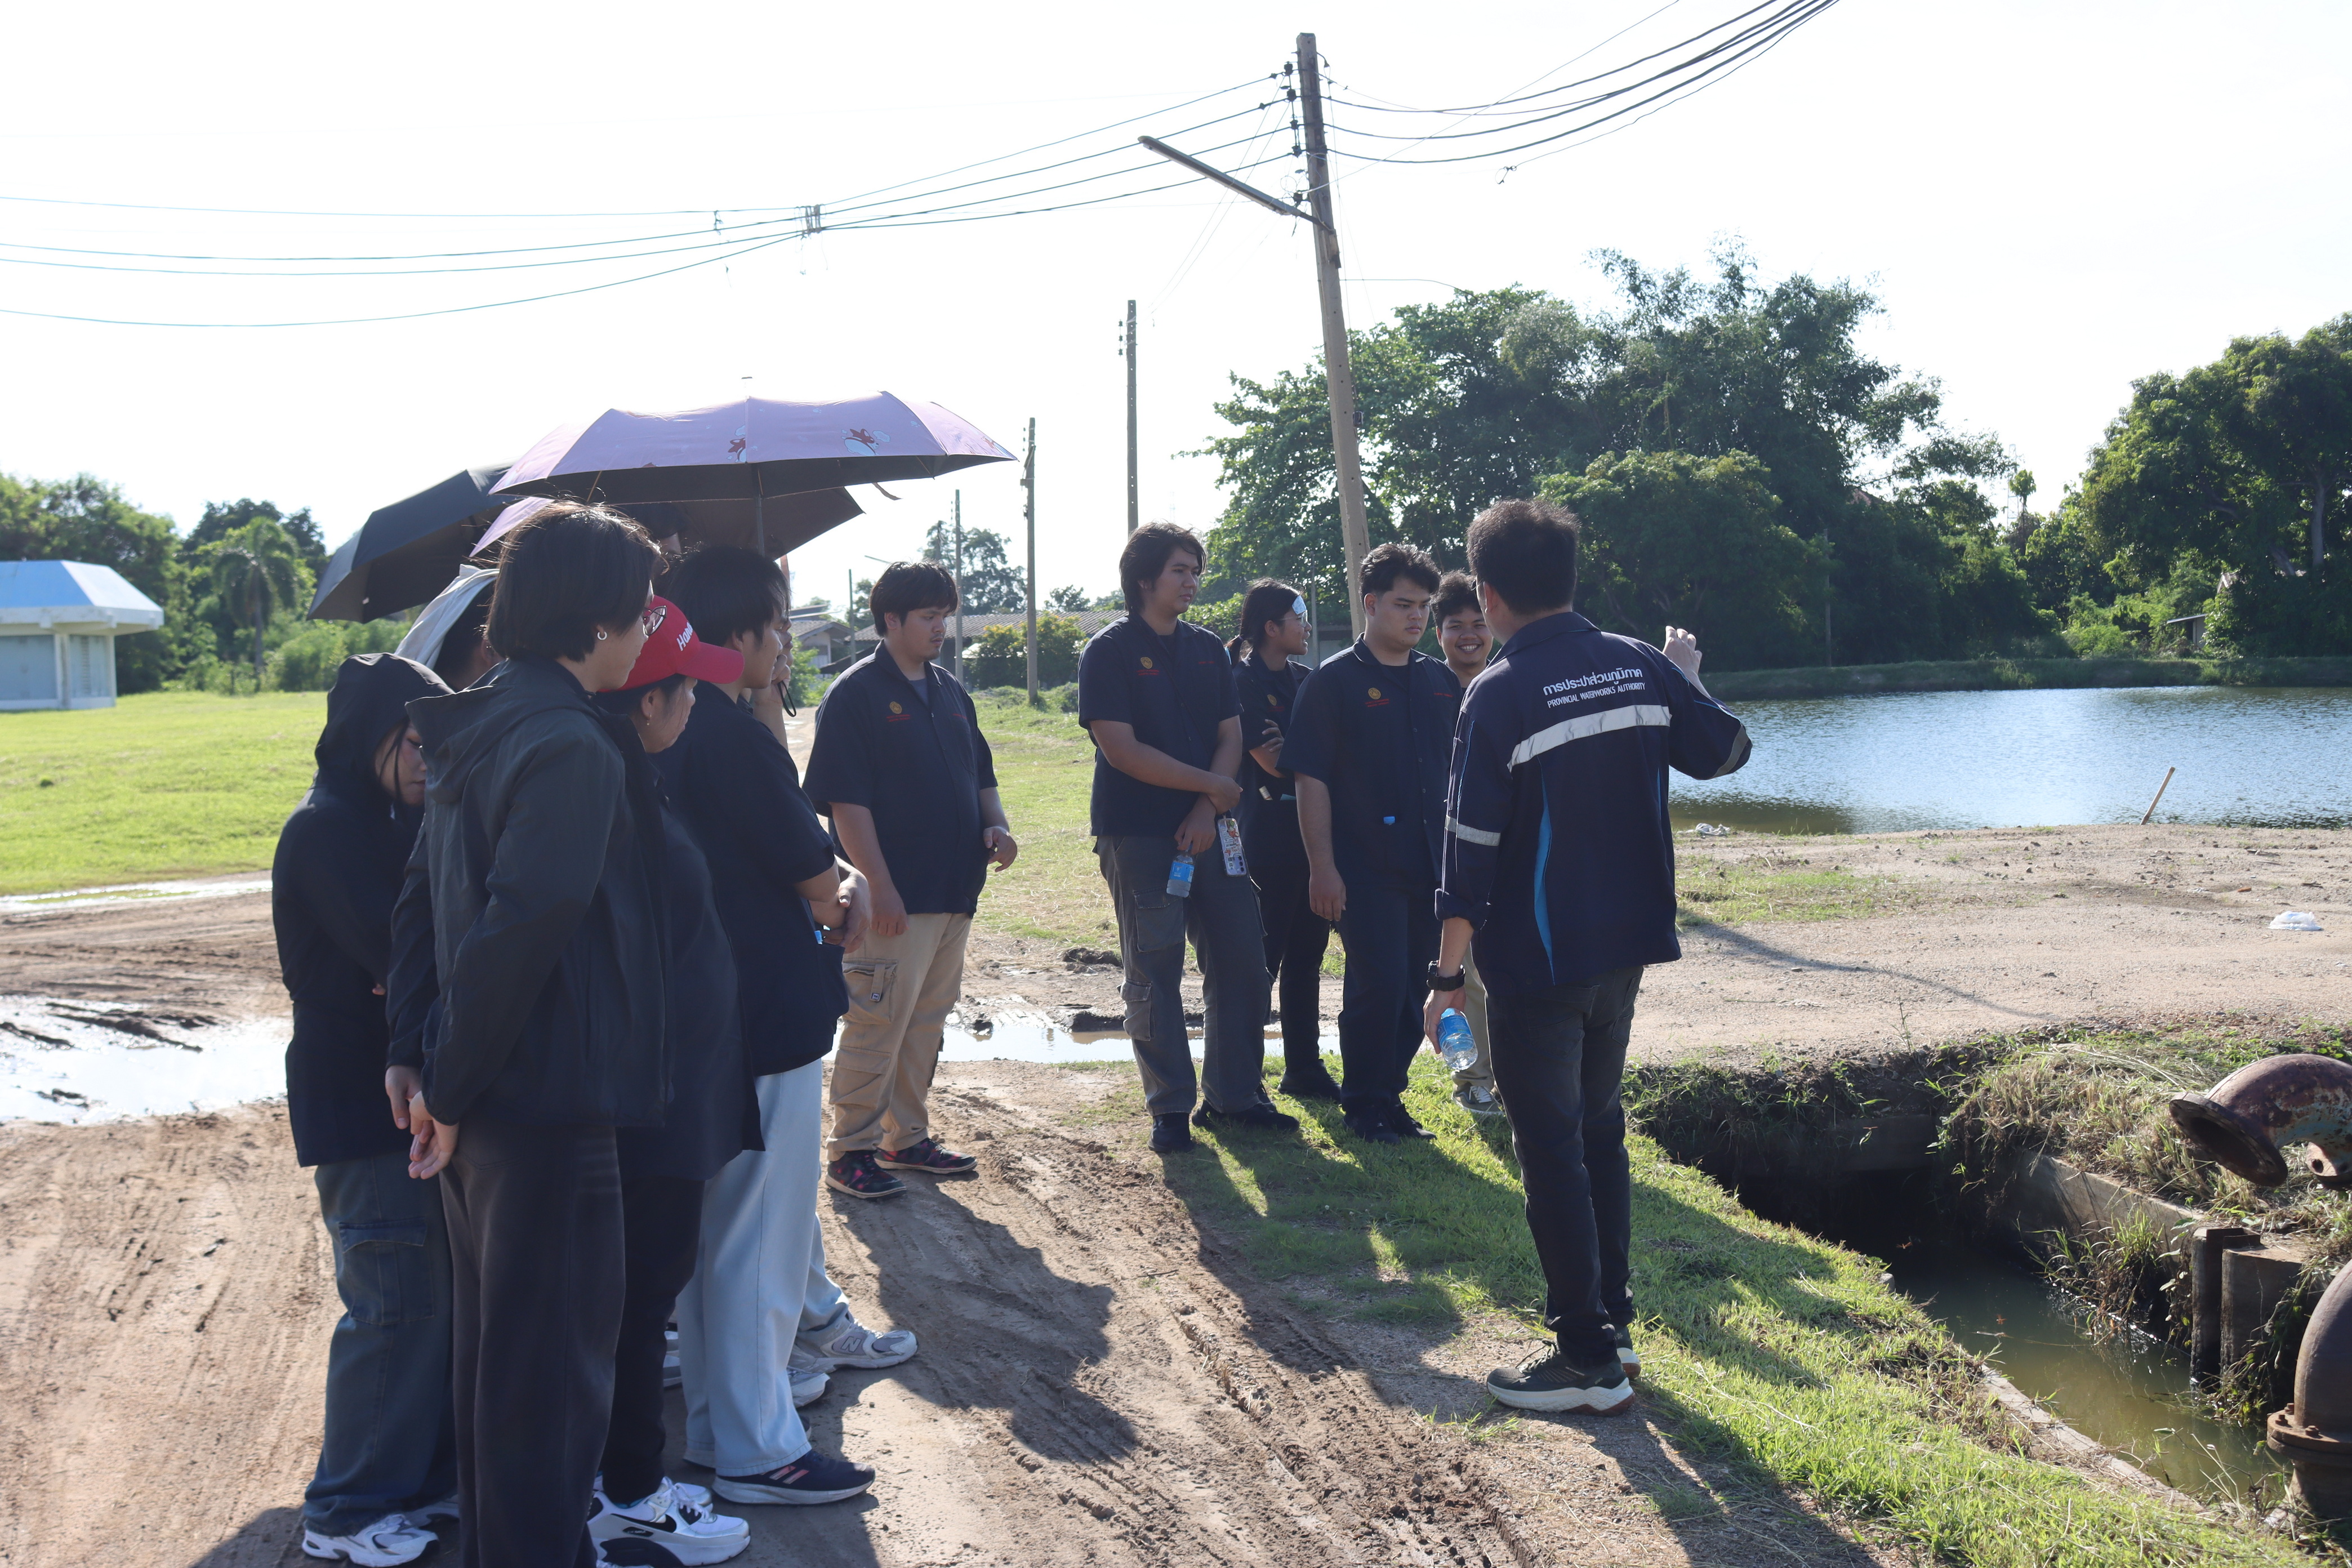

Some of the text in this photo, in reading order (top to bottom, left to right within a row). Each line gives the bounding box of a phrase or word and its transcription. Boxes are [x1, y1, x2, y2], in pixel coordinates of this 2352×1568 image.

[1543, 667, 1643, 696] การประปาส่วนภูมิภาค
[1547, 682, 1645, 709] PROVINCIAL WATERWORKS AUTHORITY
[840, 1335, 862, 1353] N
